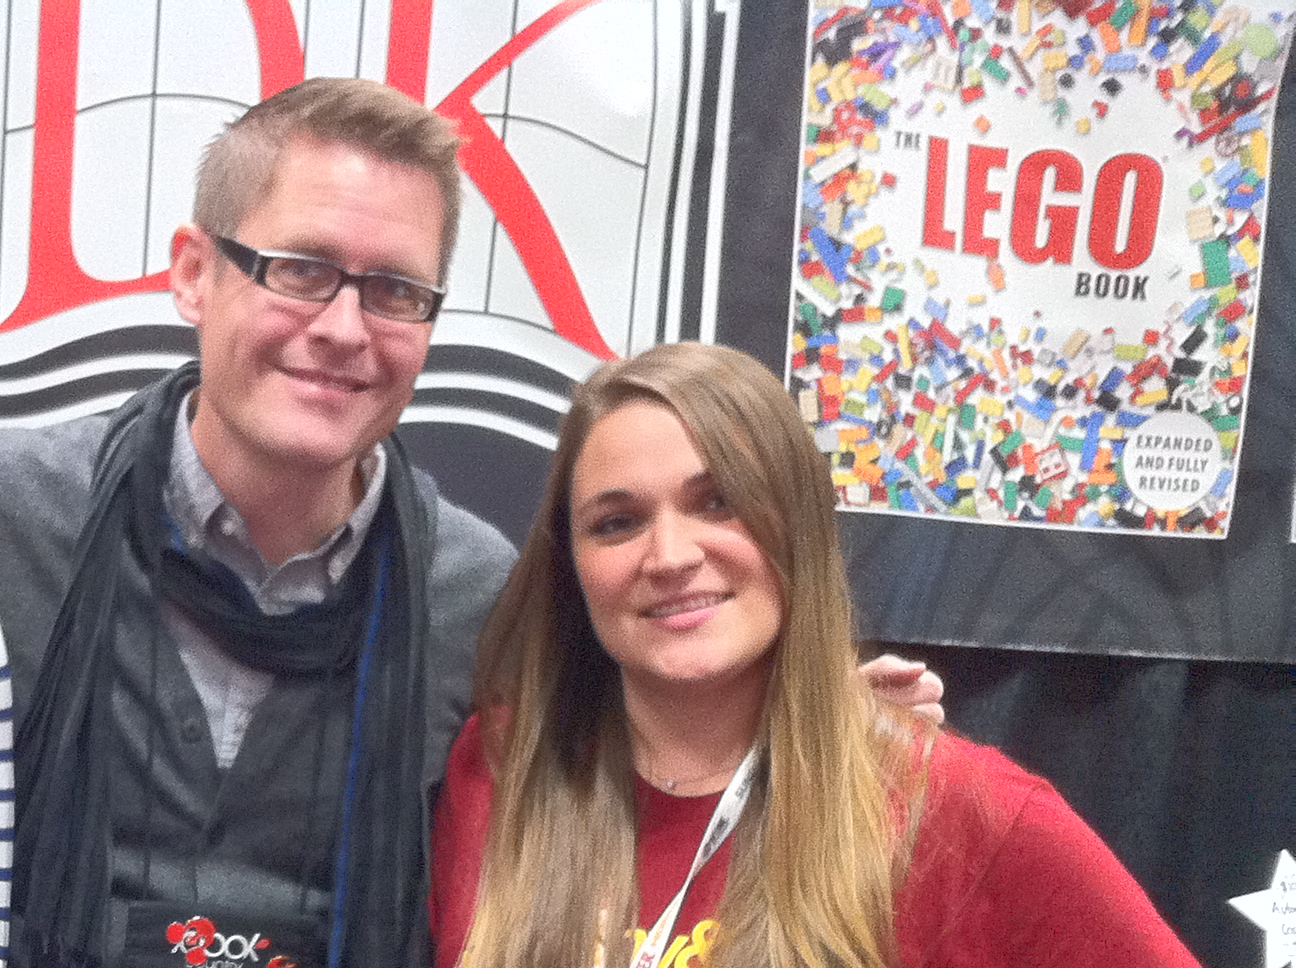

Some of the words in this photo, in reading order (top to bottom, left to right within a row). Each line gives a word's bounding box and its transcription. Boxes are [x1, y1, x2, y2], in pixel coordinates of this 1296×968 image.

[894, 130, 922, 151] THE
[922, 136, 1164, 271] LEGO
[1075, 273, 1148, 301] BOOK
[1136, 434, 1213, 452] EXPANDED
[1135, 455, 1164, 470] AND
[1168, 457, 1208, 472] FULLY
[1139, 476, 1200, 492] REVISED
